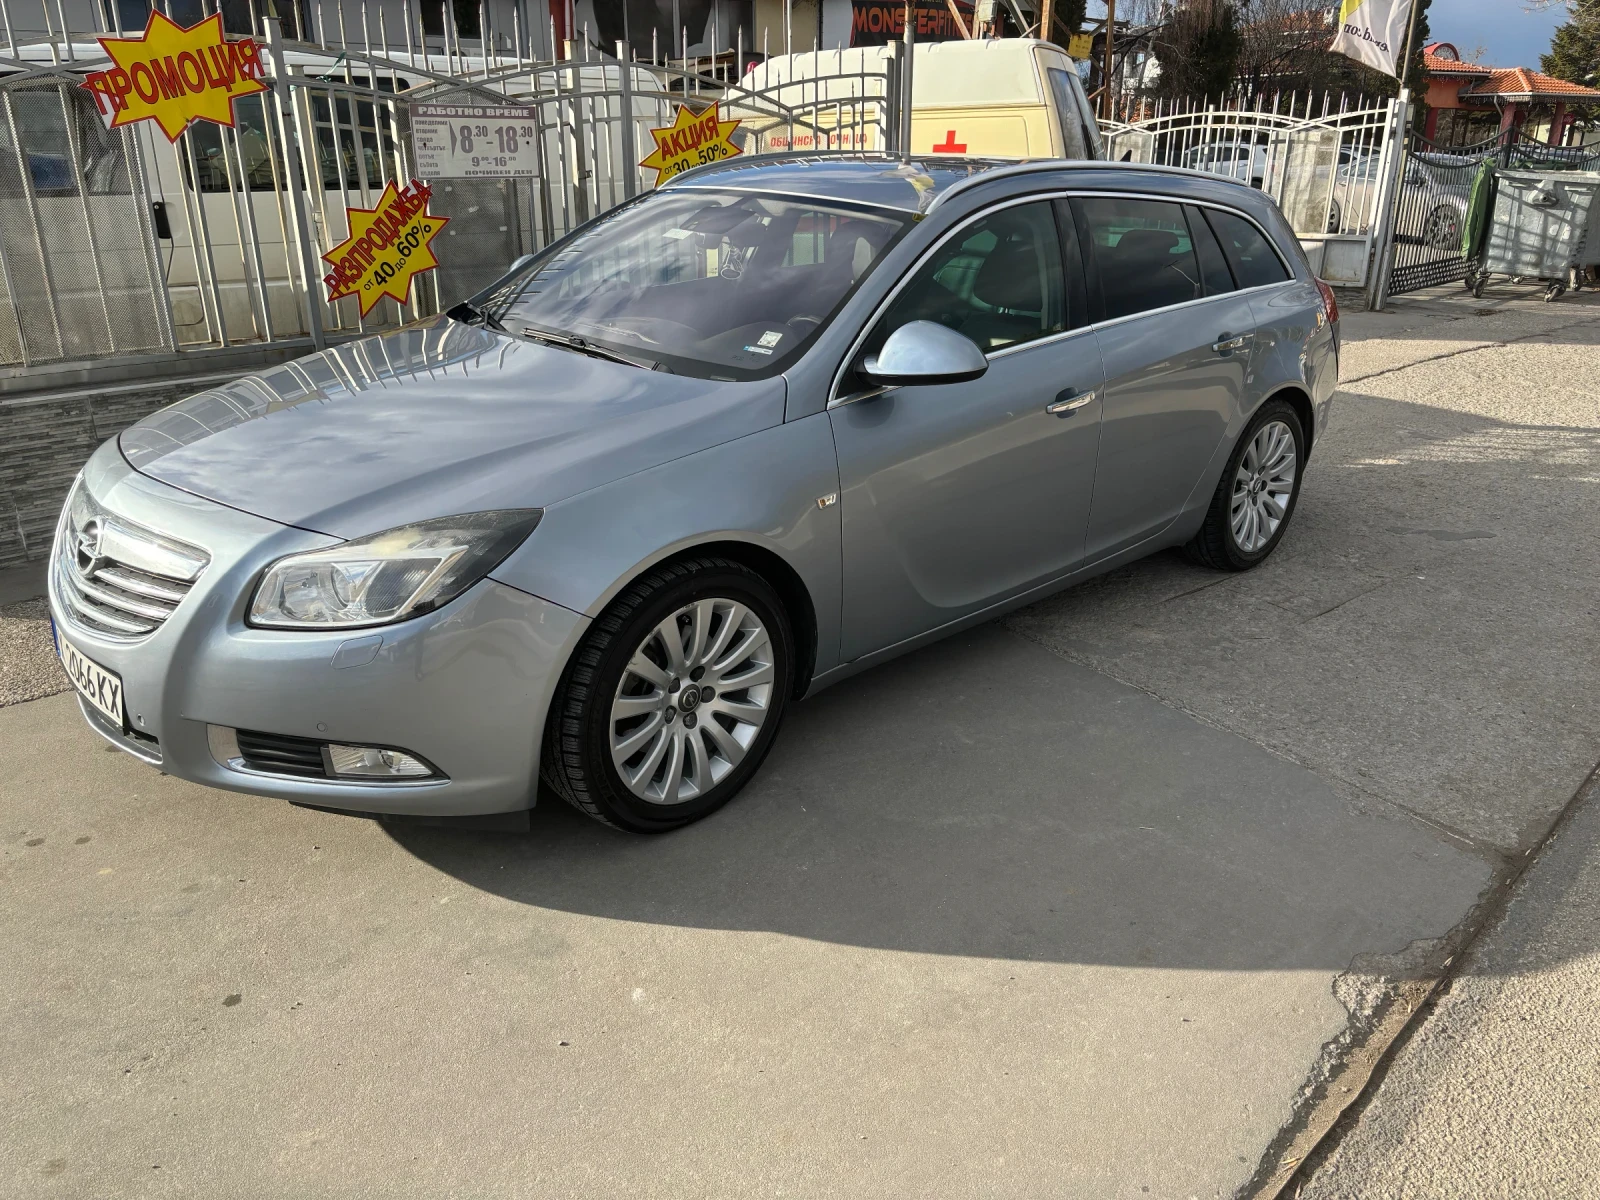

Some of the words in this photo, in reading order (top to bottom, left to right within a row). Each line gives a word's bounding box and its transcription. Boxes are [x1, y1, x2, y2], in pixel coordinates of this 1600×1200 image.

[85, 38, 265, 115] ПРОМОЦИЯ
[418, 106, 483, 116] РАБОТНО
[486, 108, 530, 117] ВРЕМЕ
[661, 115, 719, 162] АКЦИЯ
[673, 158, 690, 175] 30
[698, 142, 727, 166] 50%
[323, 178, 433, 297] РАЗПРОДАЖБА
[373, 261, 396, 286] 40
[397, 220, 432, 258] 60%
